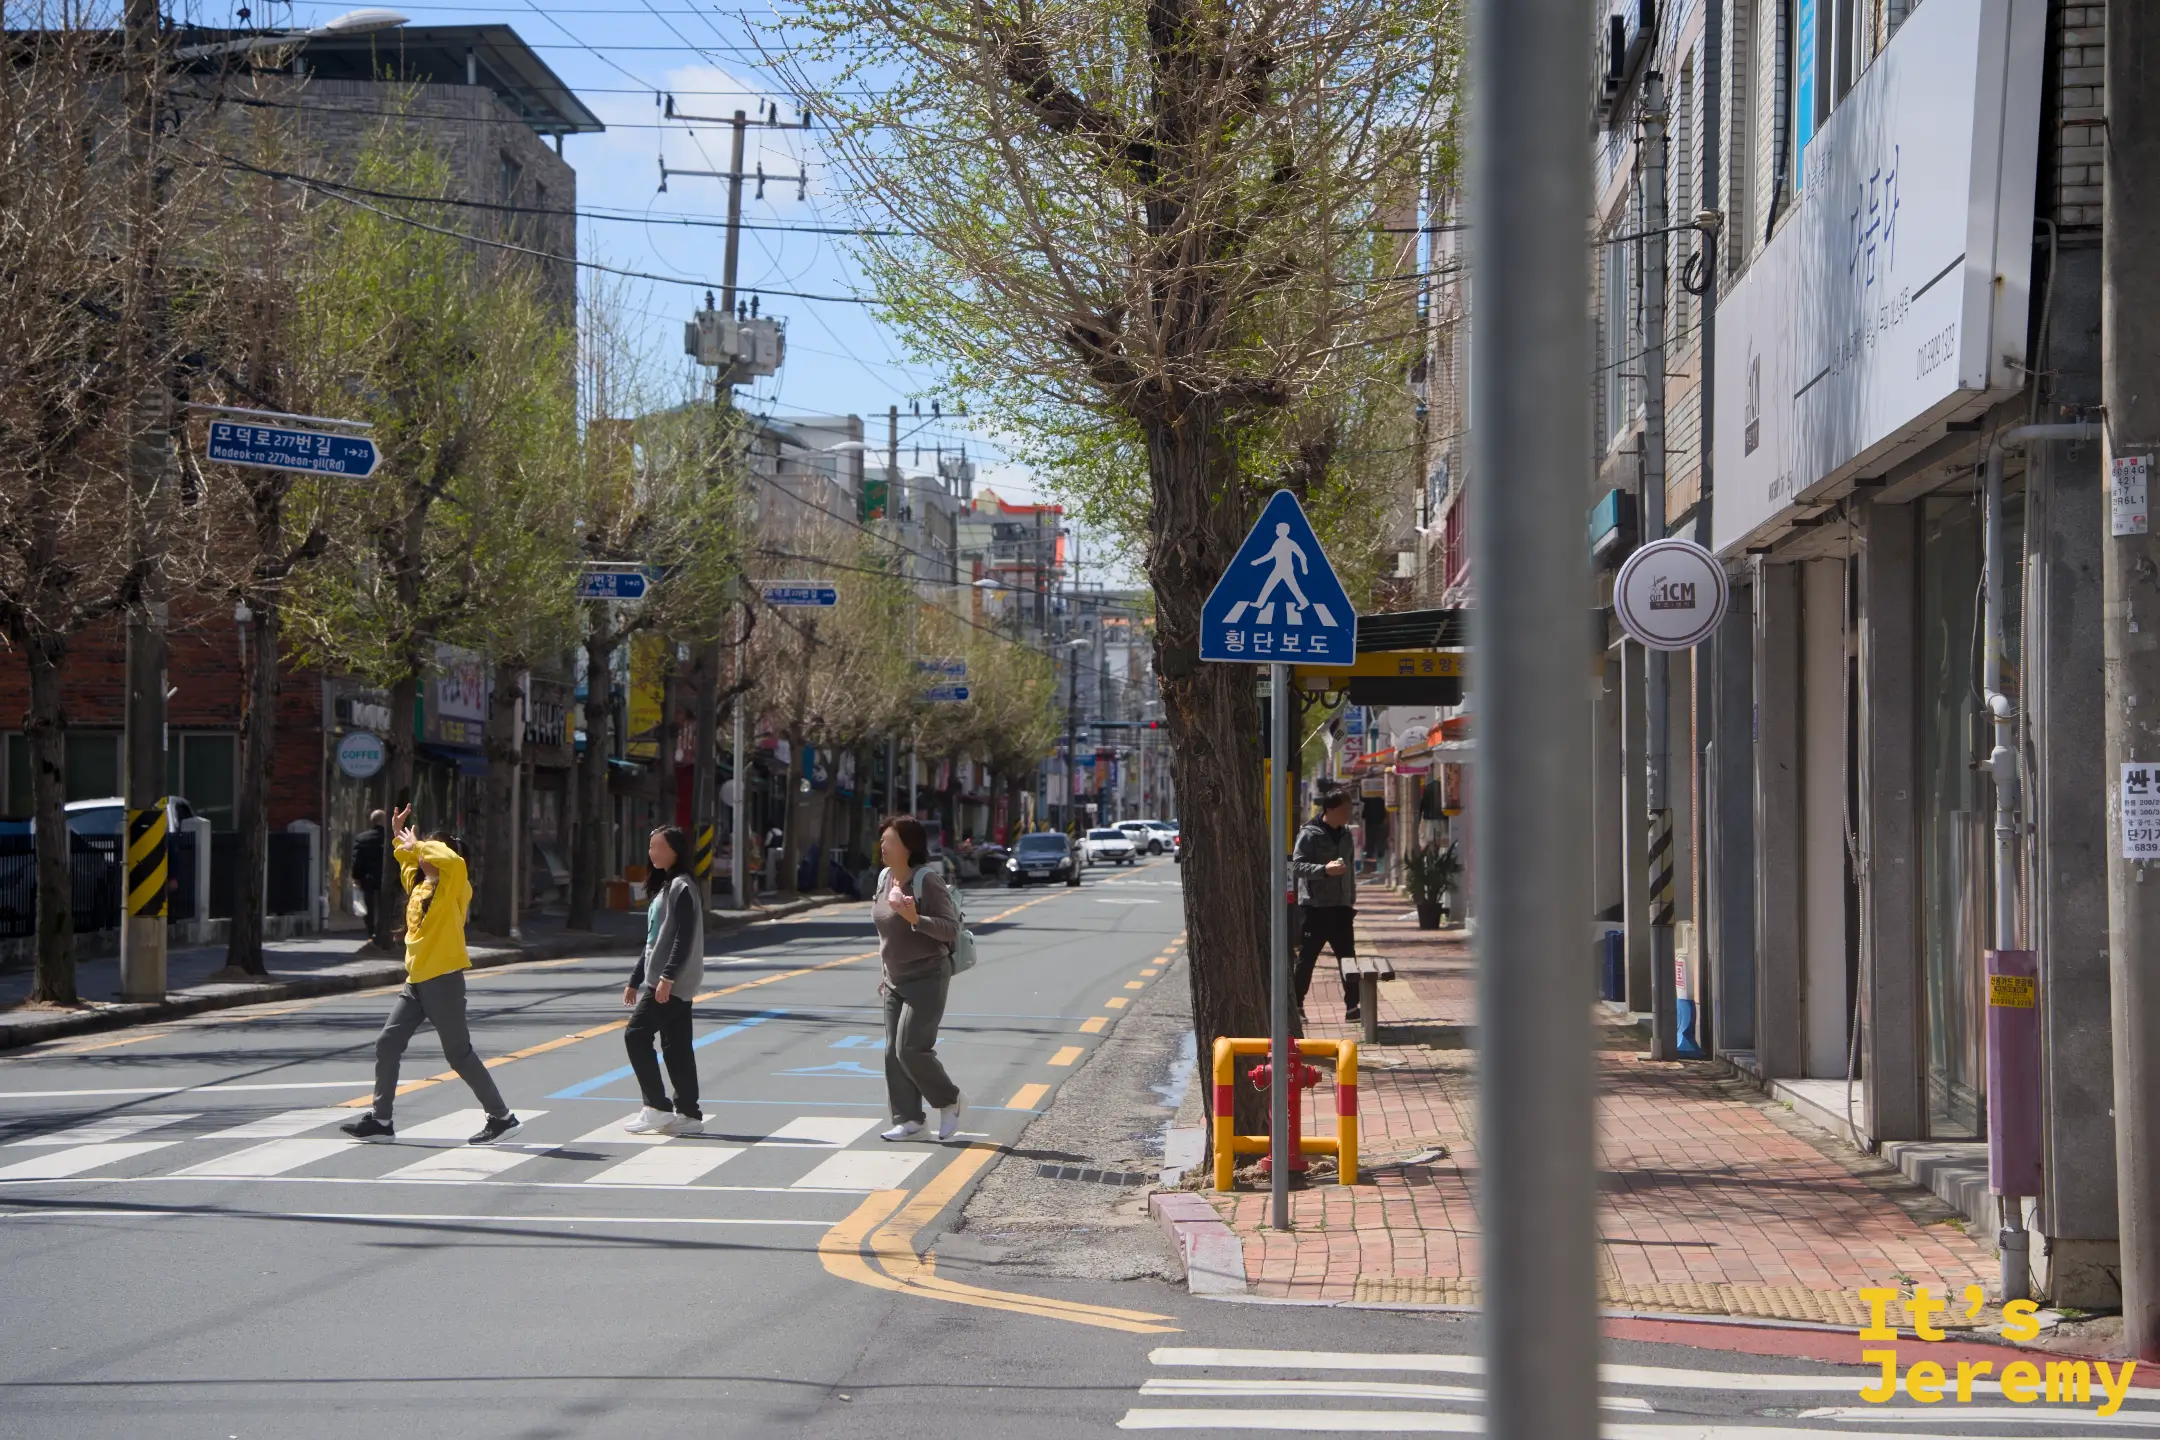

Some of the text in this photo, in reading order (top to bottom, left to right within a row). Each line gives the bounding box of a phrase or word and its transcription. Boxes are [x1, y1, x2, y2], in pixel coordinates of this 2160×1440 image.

[1850, 145, 1899, 298] 다듬다
[1890, 286, 1909, 329] 에스테틱
[215, 425, 331, 457] 모덕로277번길
[213, 446, 345, 472] Modeok-ro 277beon-gil(Rd)
[2117, 476, 2136, 485] 421
[1661, 582, 1695, 601] 1CM
[1224, 629, 1330, 654] 횡단보도
[341, 750, 379, 760] COFFEE
